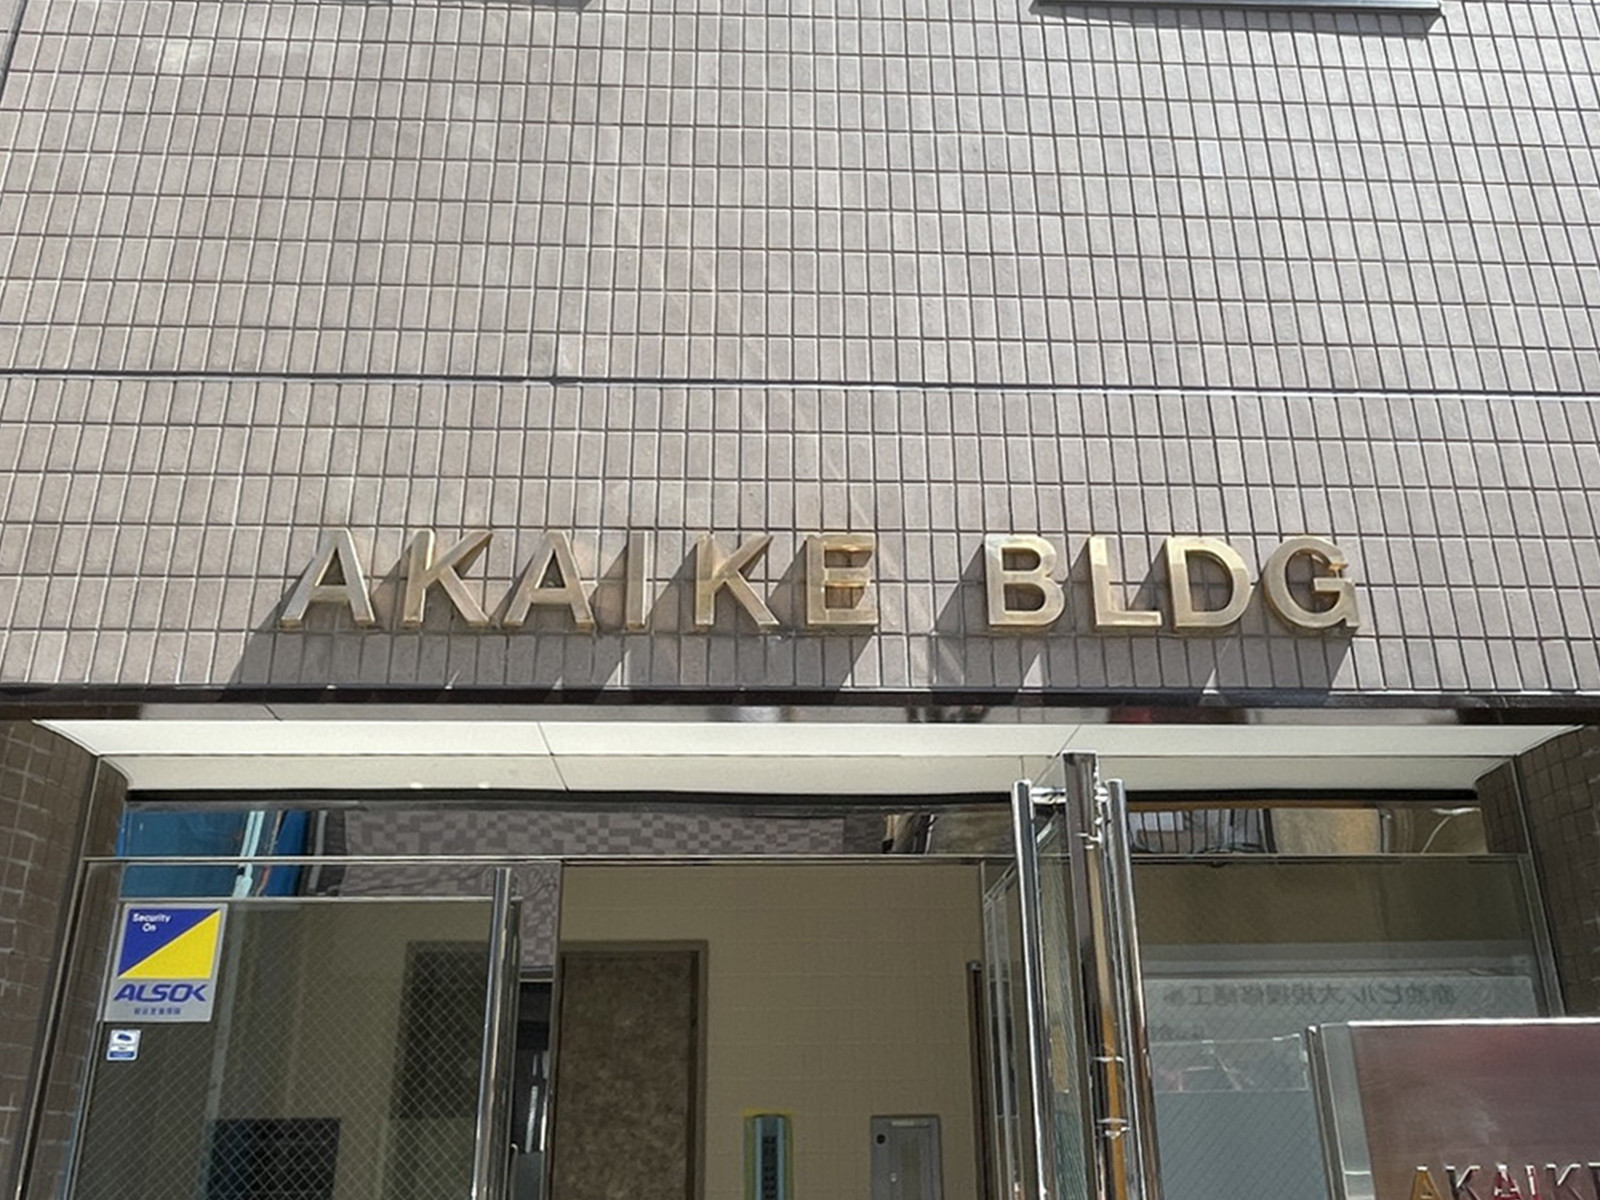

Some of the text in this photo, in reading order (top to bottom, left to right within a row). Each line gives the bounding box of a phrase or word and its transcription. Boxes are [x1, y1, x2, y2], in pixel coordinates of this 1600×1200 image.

[279, 529, 1361, 635] AKAIKE BLDG
[132, 913, 171, 924] Security
[142, 924, 157, 932] On
[115, 984, 207, 1002] ALSOK
[1410, 1163, 1600, 1200] AKAIK
